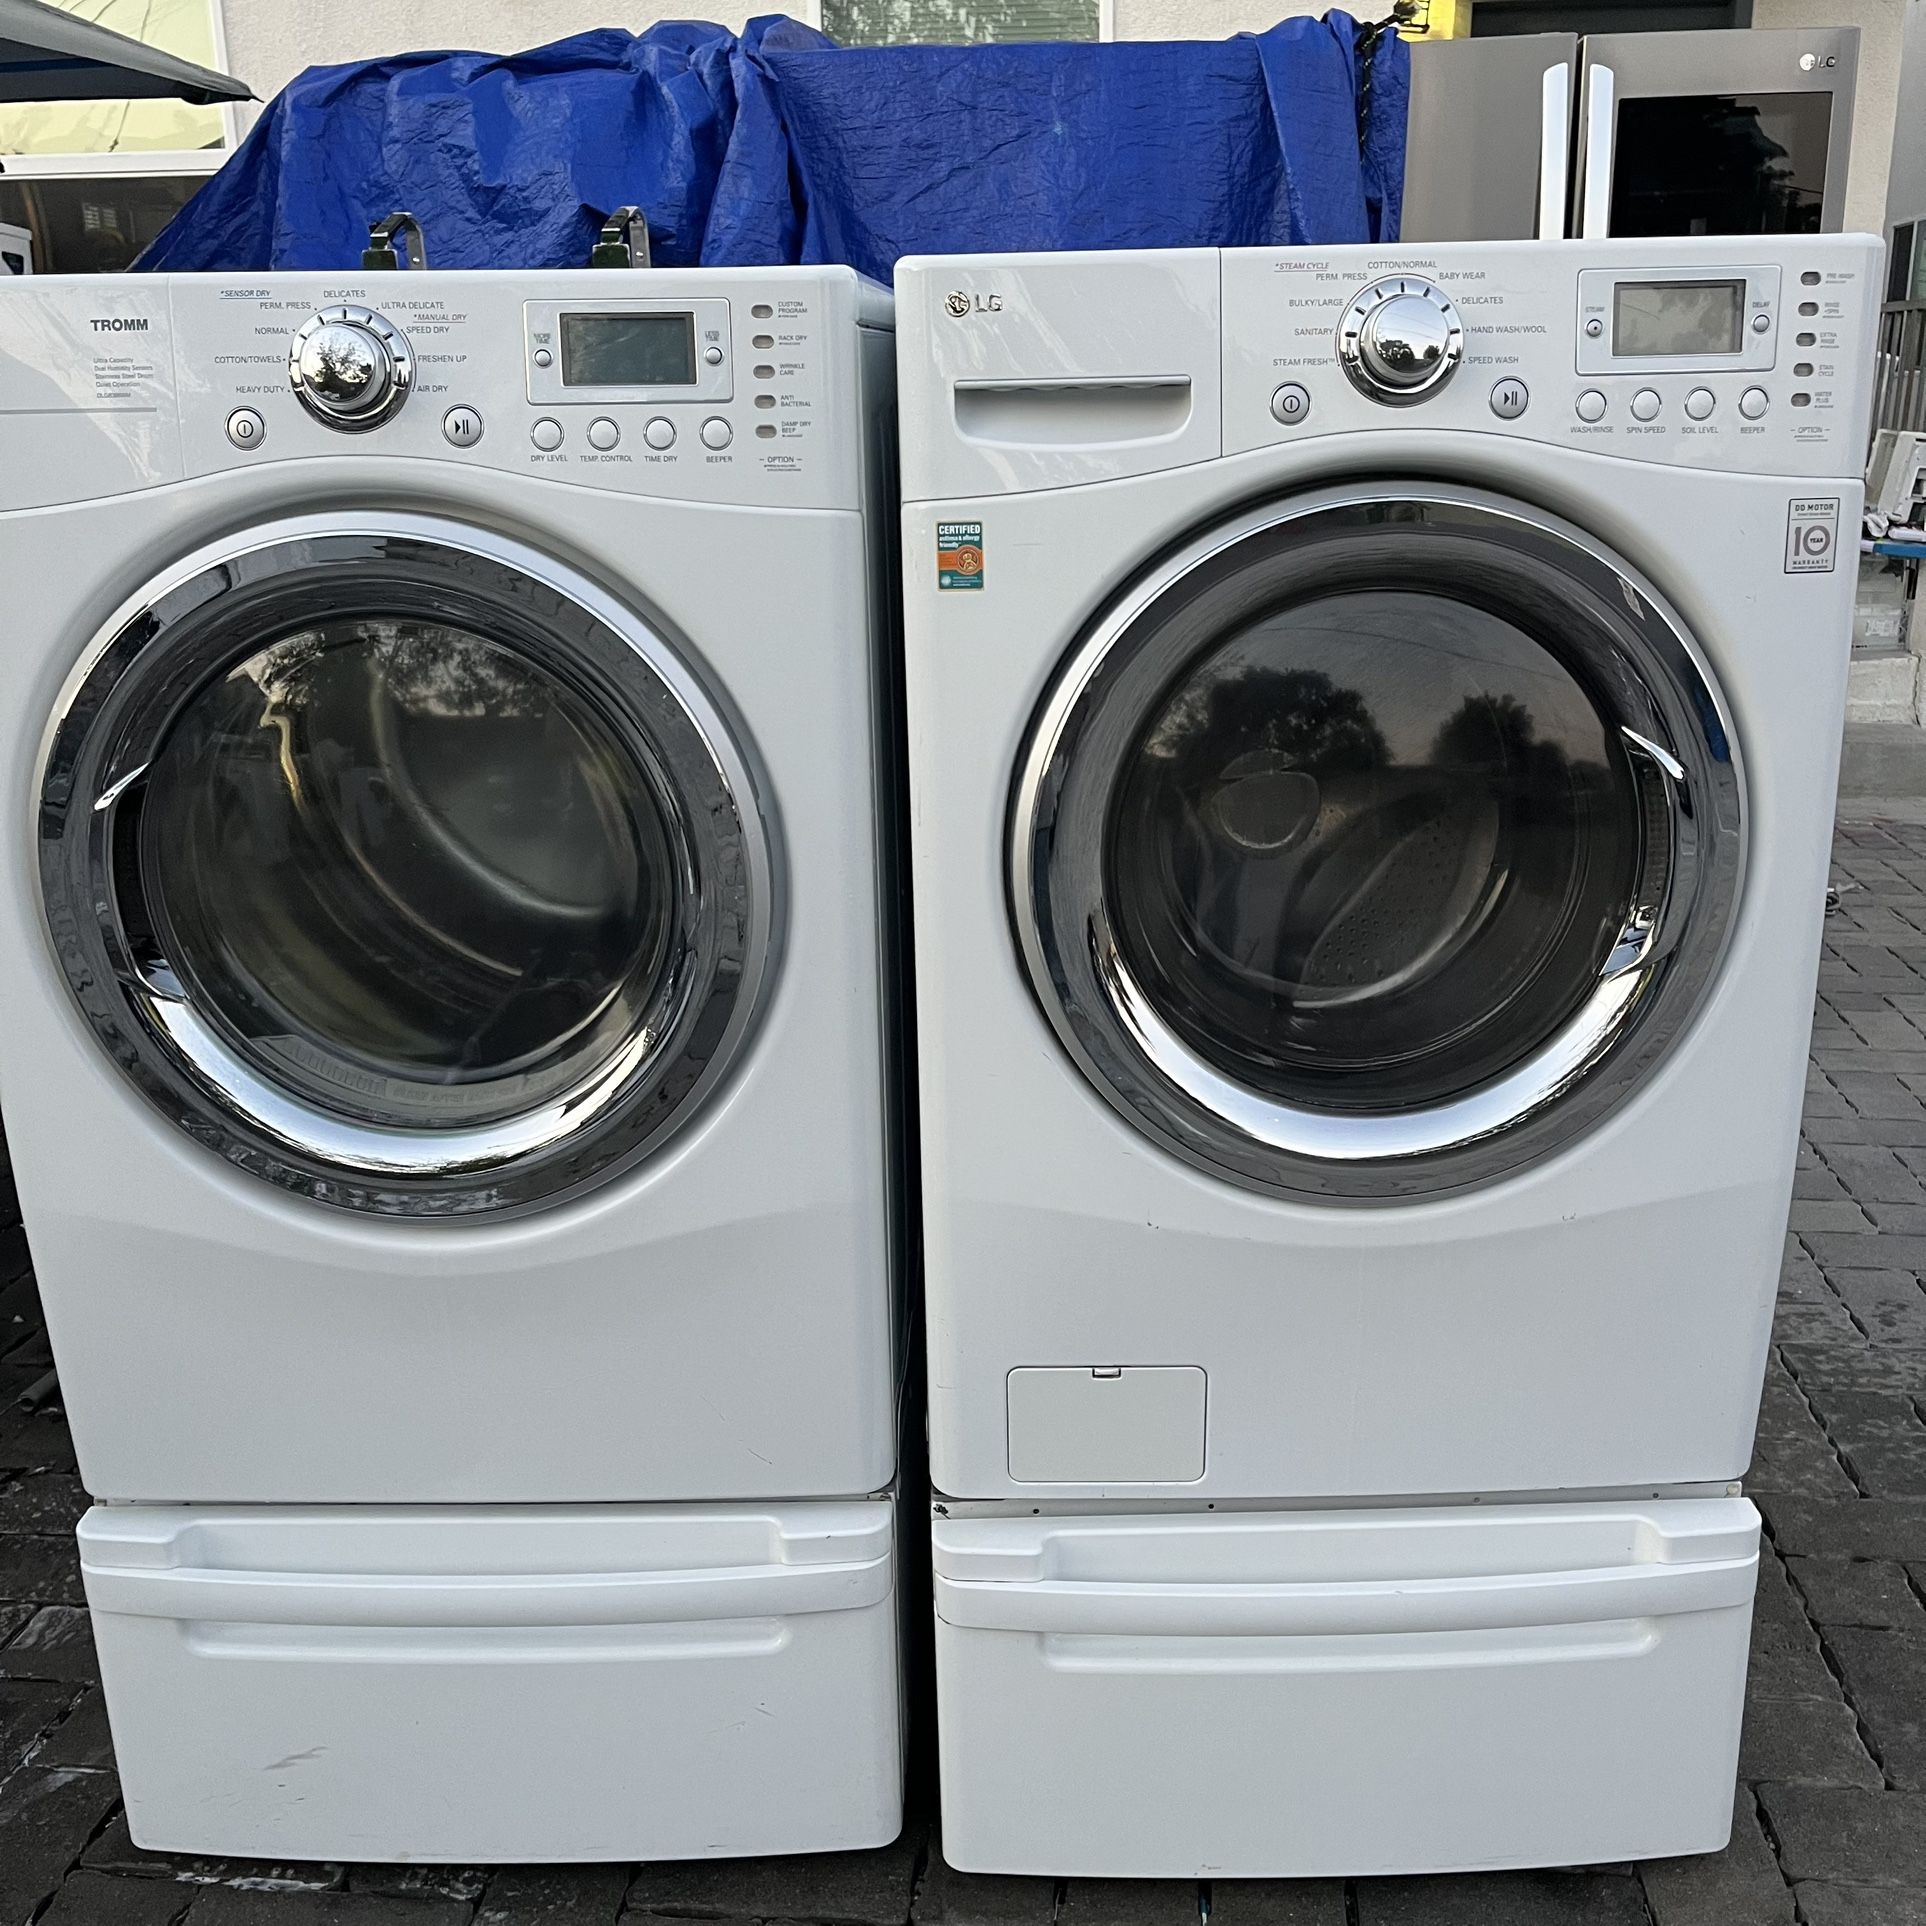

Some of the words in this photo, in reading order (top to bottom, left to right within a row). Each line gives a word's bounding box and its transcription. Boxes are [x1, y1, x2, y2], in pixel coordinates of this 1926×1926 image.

[1367, 260, 1438, 269] COTTON/NORMAL
[974, 294, 1004, 313] LG
[1289, 299, 1344, 307] BULKY/LARGE
[90, 318, 148, 332] TROMM
[1294, 328, 1334, 336] SANITARY
[214, 356, 281, 364] COTTON/TOWELS
[1272, 358, 1300, 366] STEAM
[938, 525, 981, 535] CERTIFIED
[1794, 525, 1830, 556] 10
